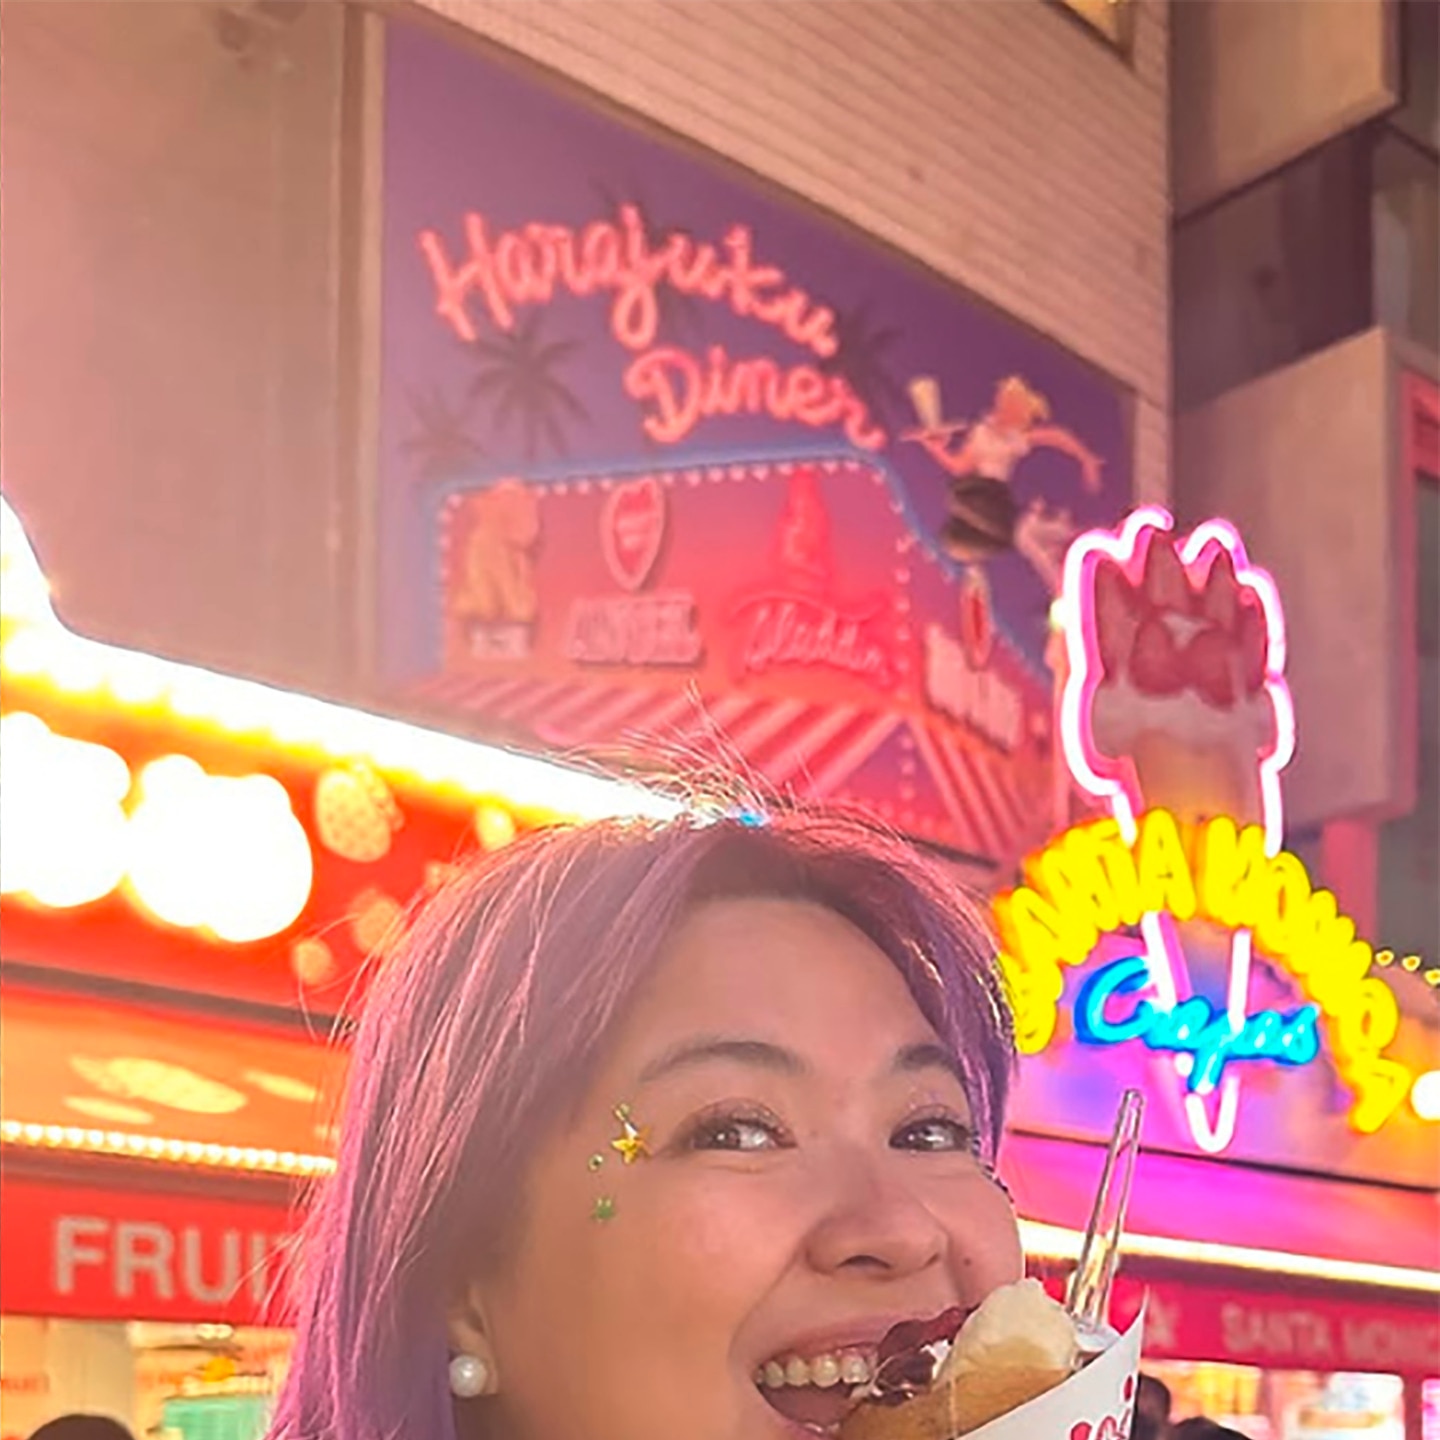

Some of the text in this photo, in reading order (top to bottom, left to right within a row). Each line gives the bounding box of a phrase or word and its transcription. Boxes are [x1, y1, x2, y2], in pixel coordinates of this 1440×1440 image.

[419, 203, 838, 356] Harajuku
[625, 345, 886, 444] Diner
[998, 808, 1411, 1133] SANTA MONICA
